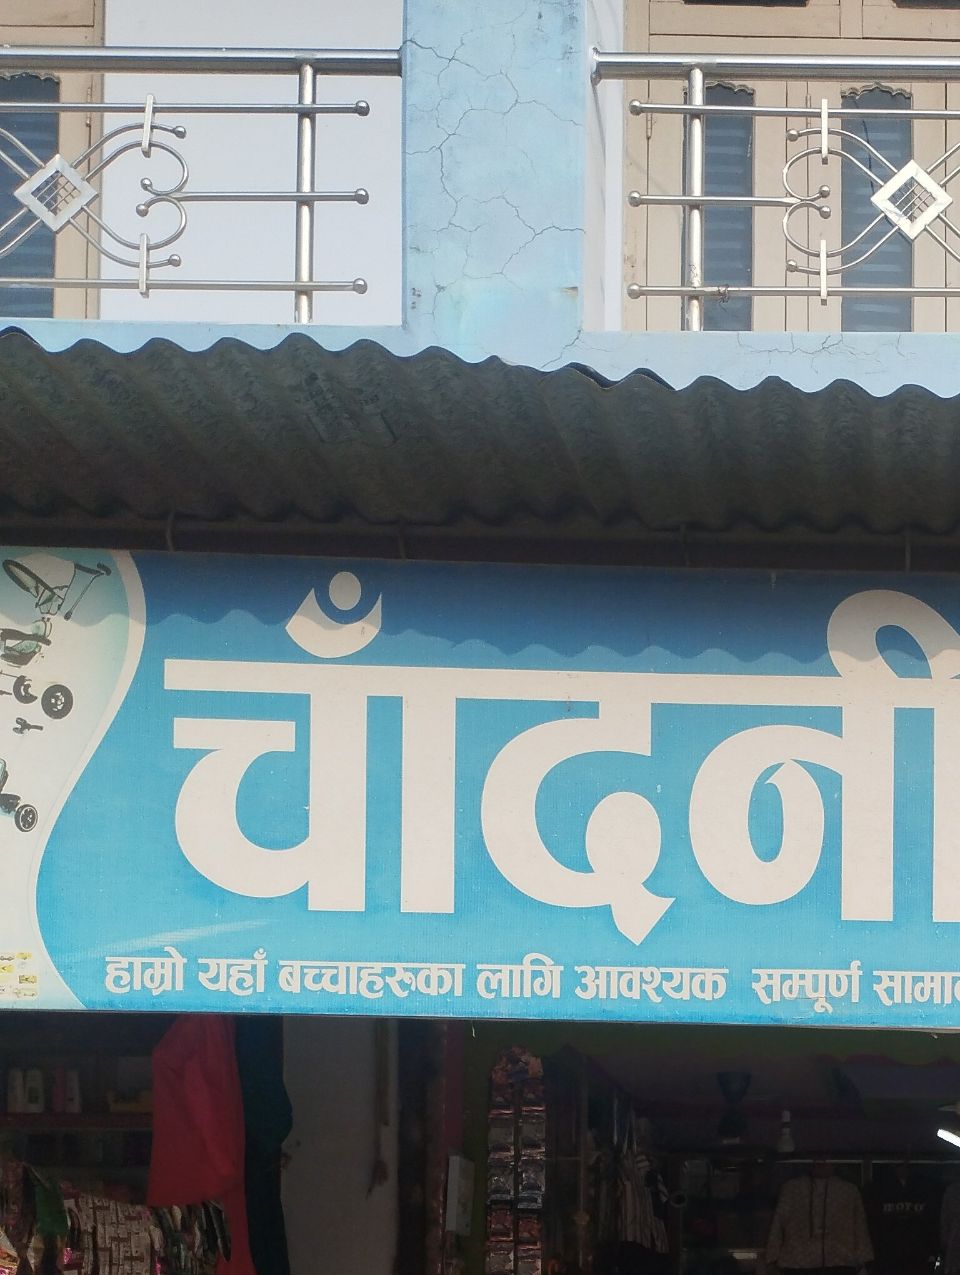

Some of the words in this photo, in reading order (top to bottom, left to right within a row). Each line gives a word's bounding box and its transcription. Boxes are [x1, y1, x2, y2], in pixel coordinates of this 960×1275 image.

[104, 946, 188, 996] हाम्रो
[198, 947, 268, 996] यहाँ
[475, 952, 565, 999] लागि
[574, 962, 729, 1003] आवश्यक
[751, 960, 864, 1013] सम्पूर्ण
